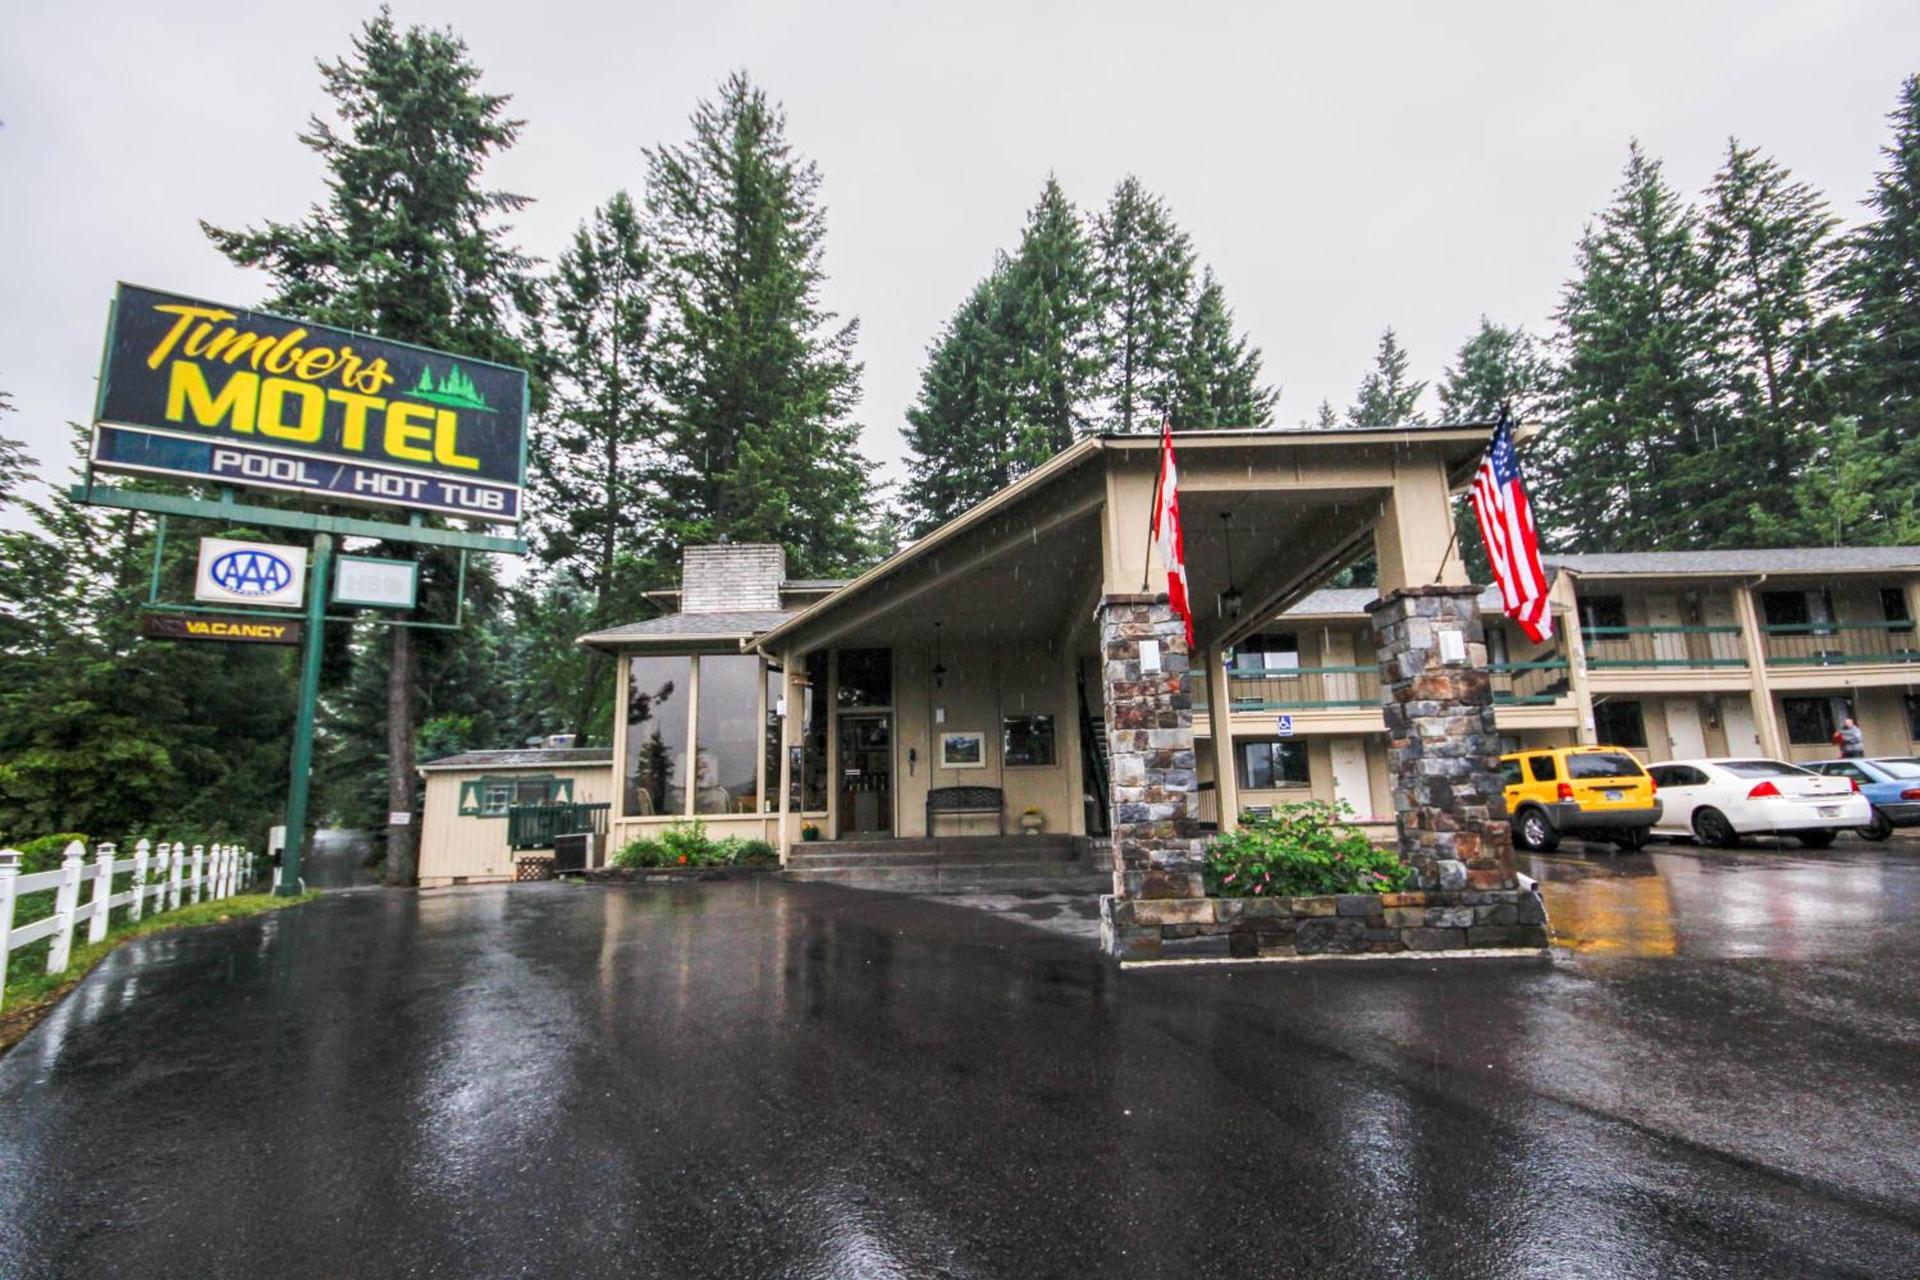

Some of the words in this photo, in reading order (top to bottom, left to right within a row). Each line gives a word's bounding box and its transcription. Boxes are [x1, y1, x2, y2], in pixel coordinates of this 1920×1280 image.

[147, 304, 395, 395] Timbers
[165, 359, 480, 471] MOTEL
[211, 449, 319, 485] POOL
[354, 470, 428, 499] HOT
[437, 482, 505, 511] TUB
[222, 553, 282, 593] AAA
[185, 620, 286, 638] VACANCY
